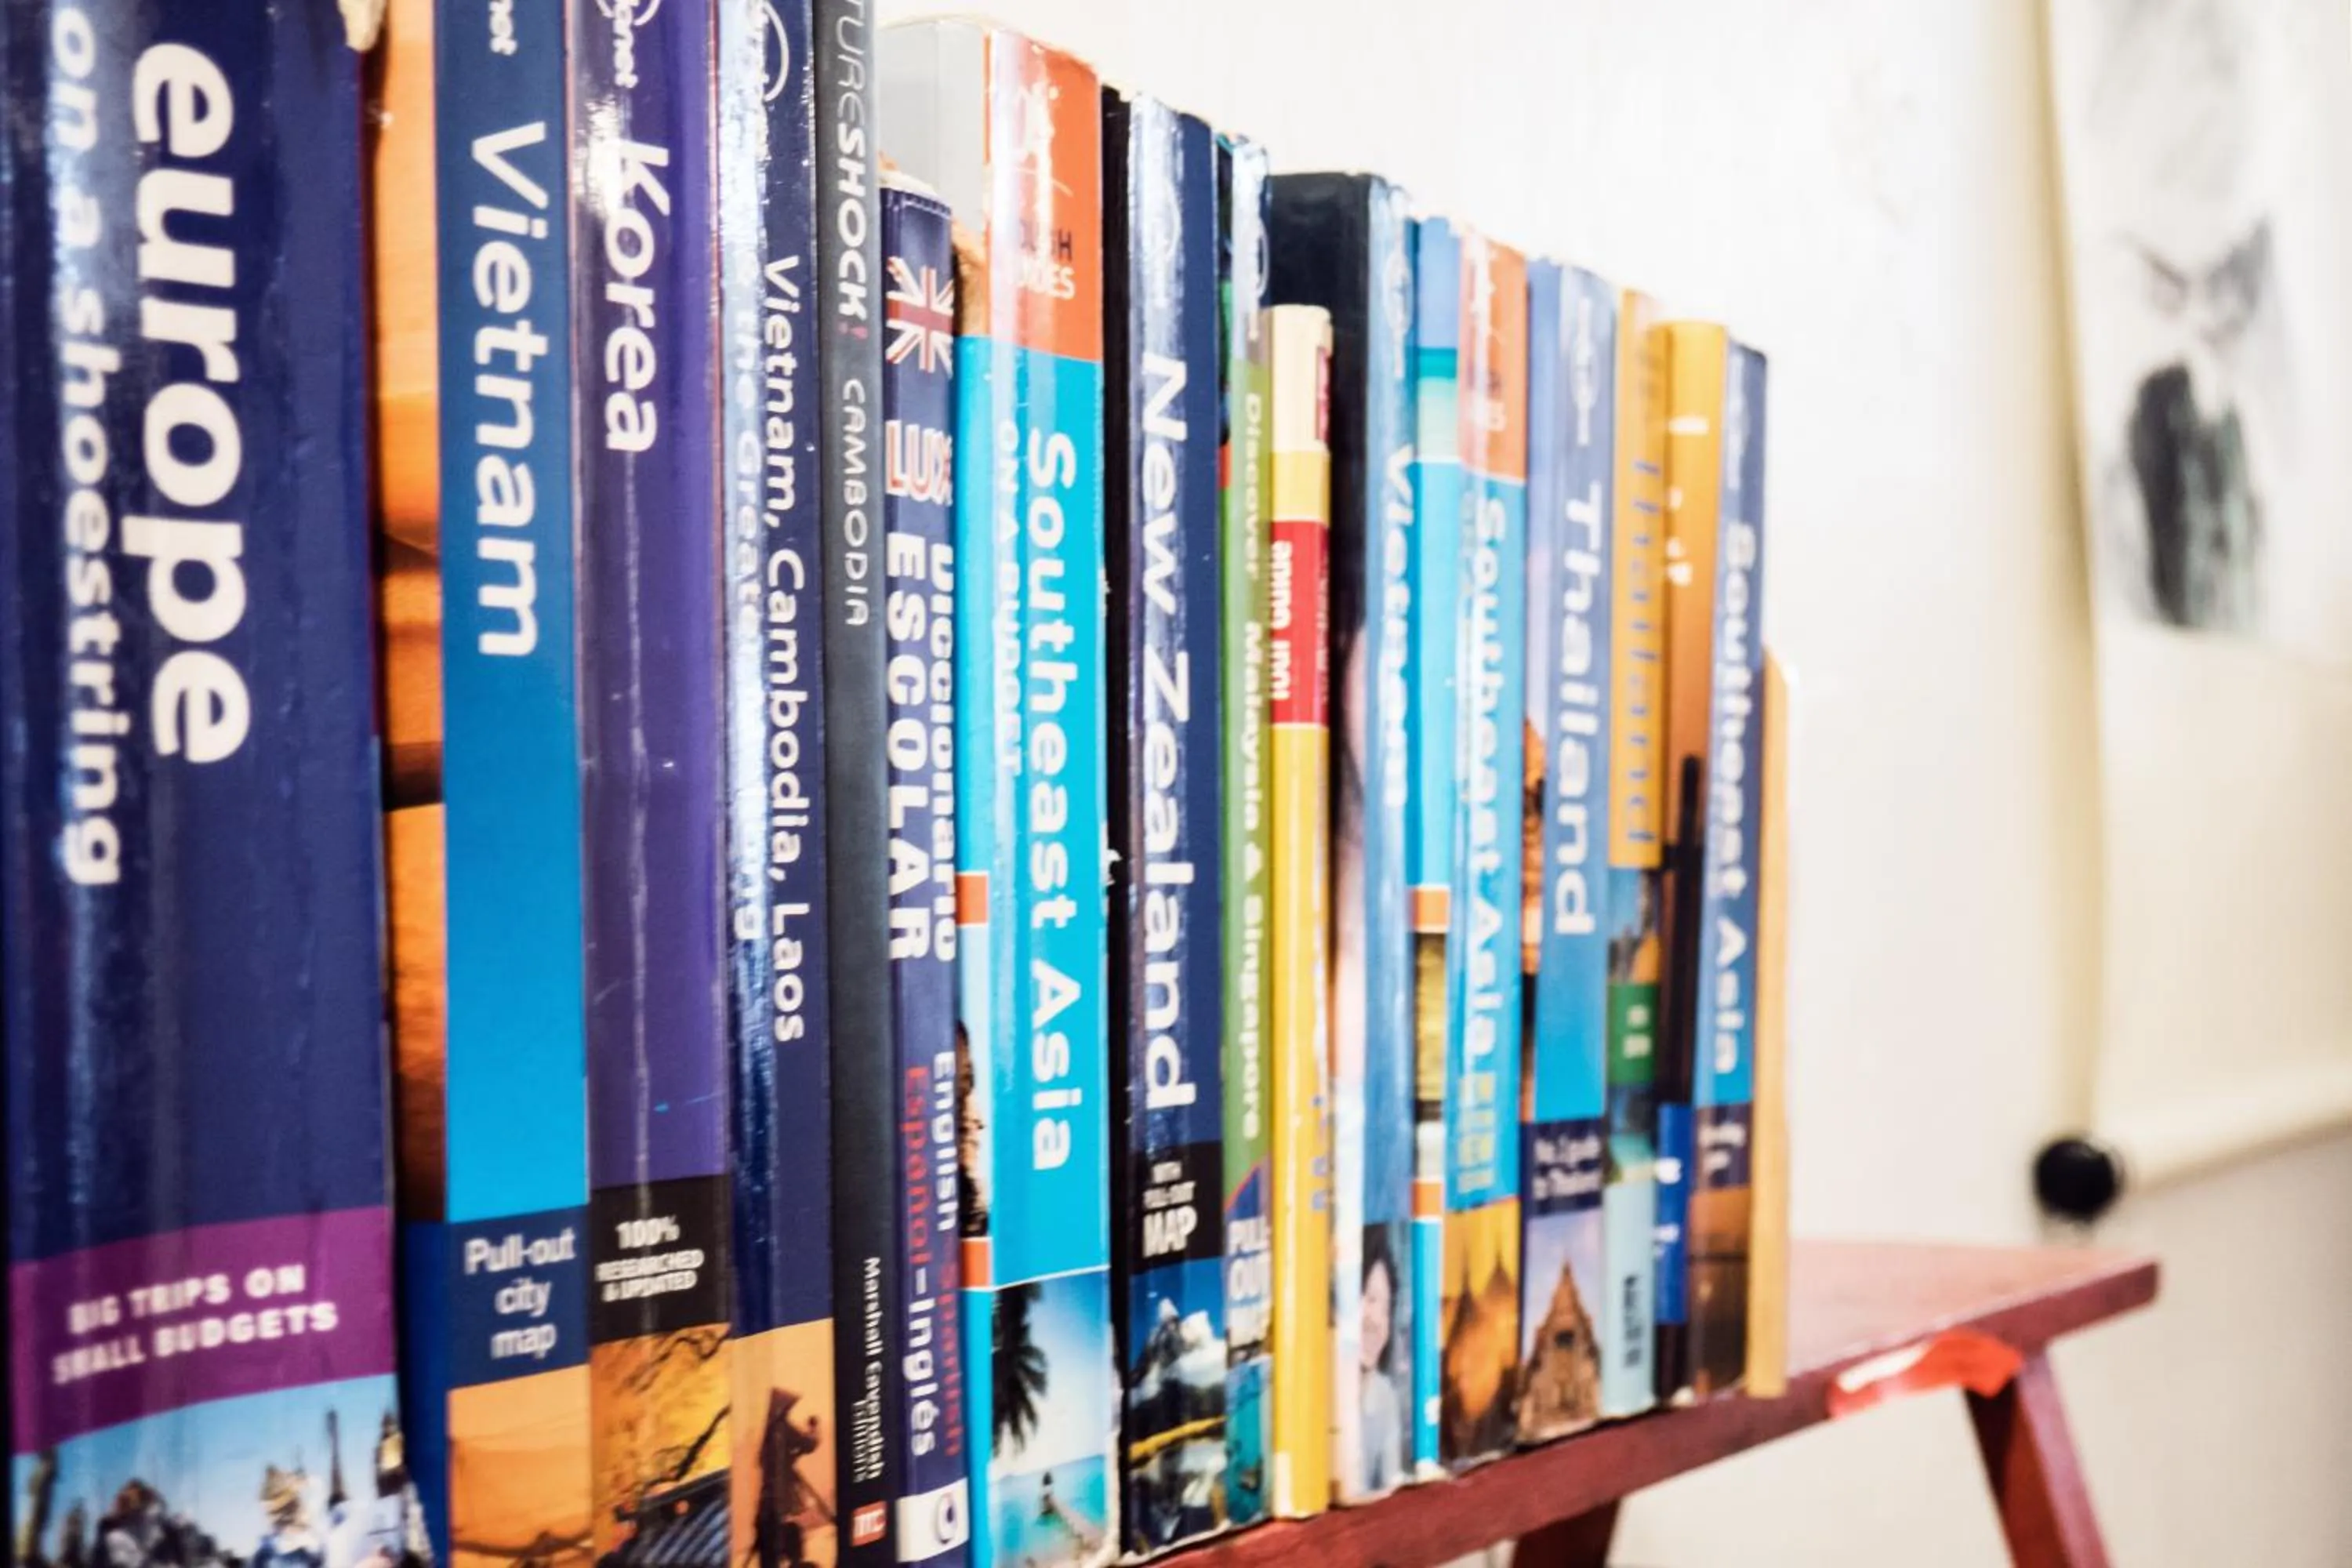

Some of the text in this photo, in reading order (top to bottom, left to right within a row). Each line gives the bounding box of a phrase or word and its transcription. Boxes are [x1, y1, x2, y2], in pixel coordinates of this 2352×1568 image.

[53, 6, 99, 151] on
[122, 43, 251, 763] europe
[472, 121, 548, 657] Vietnam
[604, 138, 670, 453] Korea
[62, 288, 130, 884] shoestring
[842, 379, 869, 626] CAMBODIA
[1142, 351, 1187, 615] New
[1244, 394, 1261, 579] Discover
[764, 255, 811, 1042] Vietnam, Cambodia, Laos
[887, 532, 931, 960] ESCOLAR
[1240, 621, 1264, 831] Malaysia
[1555, 479, 1602, 935] Thailand
[1027, 426, 1082, 1170] Southeast Asia
[1142, 643, 1196, 1109] Zealand
[1238, 894, 1263, 1139] Singapore
[52, 1301, 339, 1387] SMALL BUDGETS
[68, 1262, 307, 1335] BIG TRIPS ON
[464, 1227, 577, 1275] Pull-out
[490, 1323, 557, 1360] map
[495, 1276, 553, 1318] city
[615, 1214, 681, 1250] 100%
[1142, 1205, 1198, 1259] MAP
